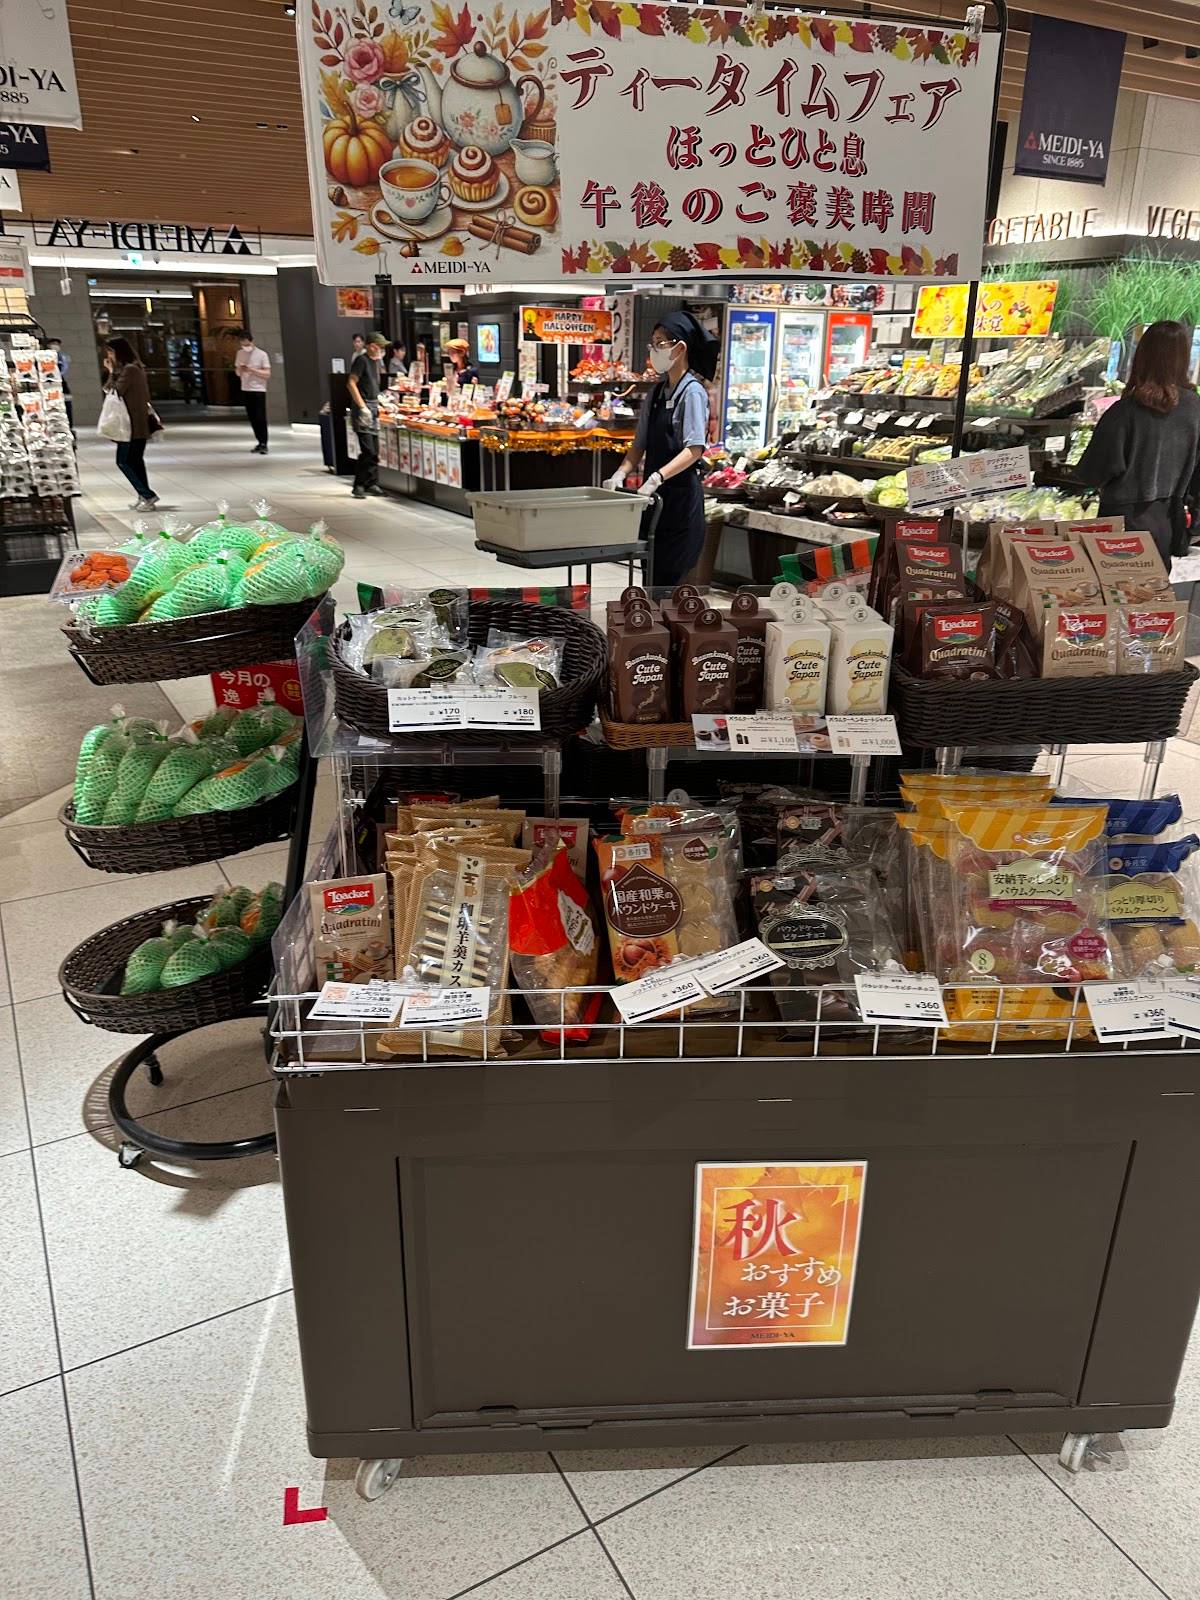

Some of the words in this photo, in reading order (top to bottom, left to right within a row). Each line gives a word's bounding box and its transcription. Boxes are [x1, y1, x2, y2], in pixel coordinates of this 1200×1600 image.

[560, 46, 962, 130] ティータイムフェア
[667, 123, 868, 176] ほっとひと息
[1039, 133, 1104, 159] MEIDI-YA
[1042, 153, 1066, 166] SINCE
[579, 180, 937, 235] 午後のご褒美時間
[423, 261, 492, 274] MEIDI-YA
[555, 312, 583, 321] HAPPY
[544, 321, 594, 332] HALLOWEEN
[899, 525, 935, 536] Loacker
[1100, 560, 1154, 569] Quadratini
[905, 566, 957, 580] Quadratini
[1030, 566, 1085, 576] Quadratini
[938, 619, 978, 631] Loacker
[1132, 617, 1170, 629] Loacker
[929, 646, 988, 662] Quadratini
[1051, 646, 1109, 660] Quadratini
[636, 664, 660, 674] Cute
[702, 661, 727, 671] Cute
[794, 660, 818, 670] Cute
[857, 660, 881, 670] Cute
[219, 670, 271, 688] 今月の
[632, 673, 663, 685] Japan
[697, 671, 729, 681] Japan
[789, 670, 820, 680] Japan
[851, 670, 882, 680] Japan
[328, 889, 370, 903] Loacker
[1000, 887, 1065, 897] バウムクーヘン
[321, 918, 381, 935] Quadratini
[777, 923, 828, 934] パウンドケーキ
[782, 933, 826, 941] ビターチョコ
[979, 952, 987, 966] 8
[723, 1198, 802, 1261] 秋
[740, 1256, 842, 1288] おすすめ
[722, 1291, 825, 1319] お菓子
